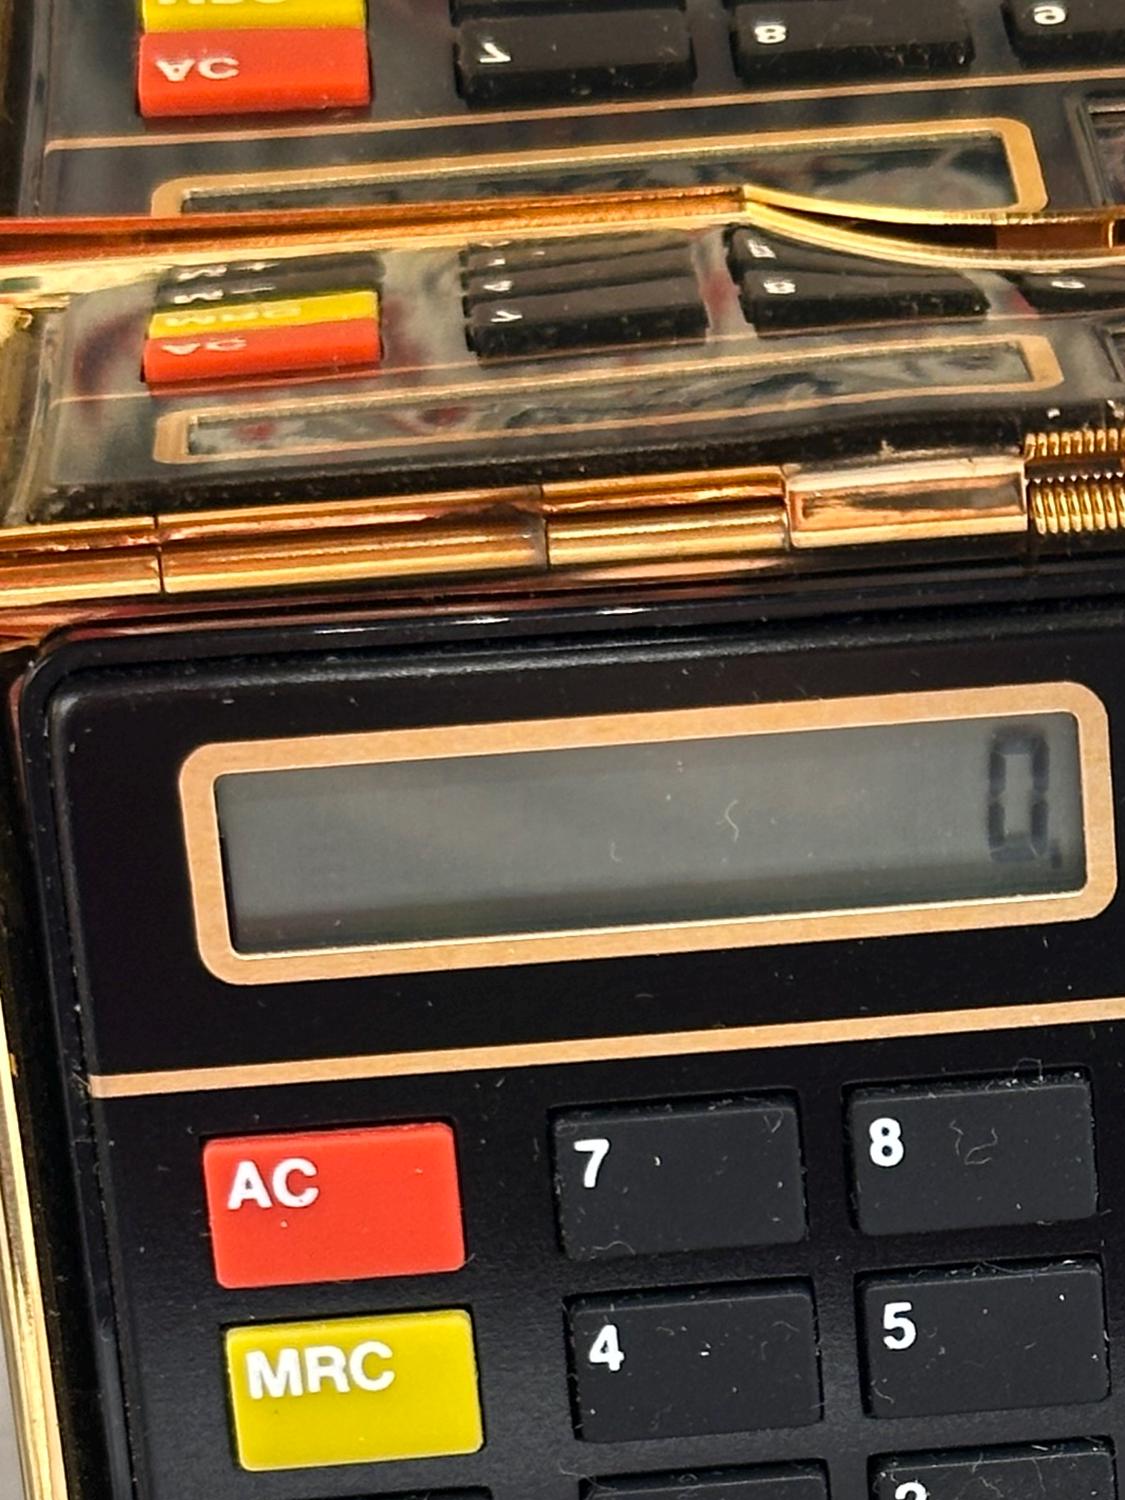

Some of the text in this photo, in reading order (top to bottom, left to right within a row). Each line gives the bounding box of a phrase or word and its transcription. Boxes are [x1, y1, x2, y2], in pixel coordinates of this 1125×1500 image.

[573, 1138, 610, 1188] 7
[868, 1117, 904, 1167] 8
[227, 1157, 319, 1210] AC
[588, 1324, 625, 1372] 4
[883, 1301, 917, 1350] 5
[245, 1340, 395, 1399] MRC
